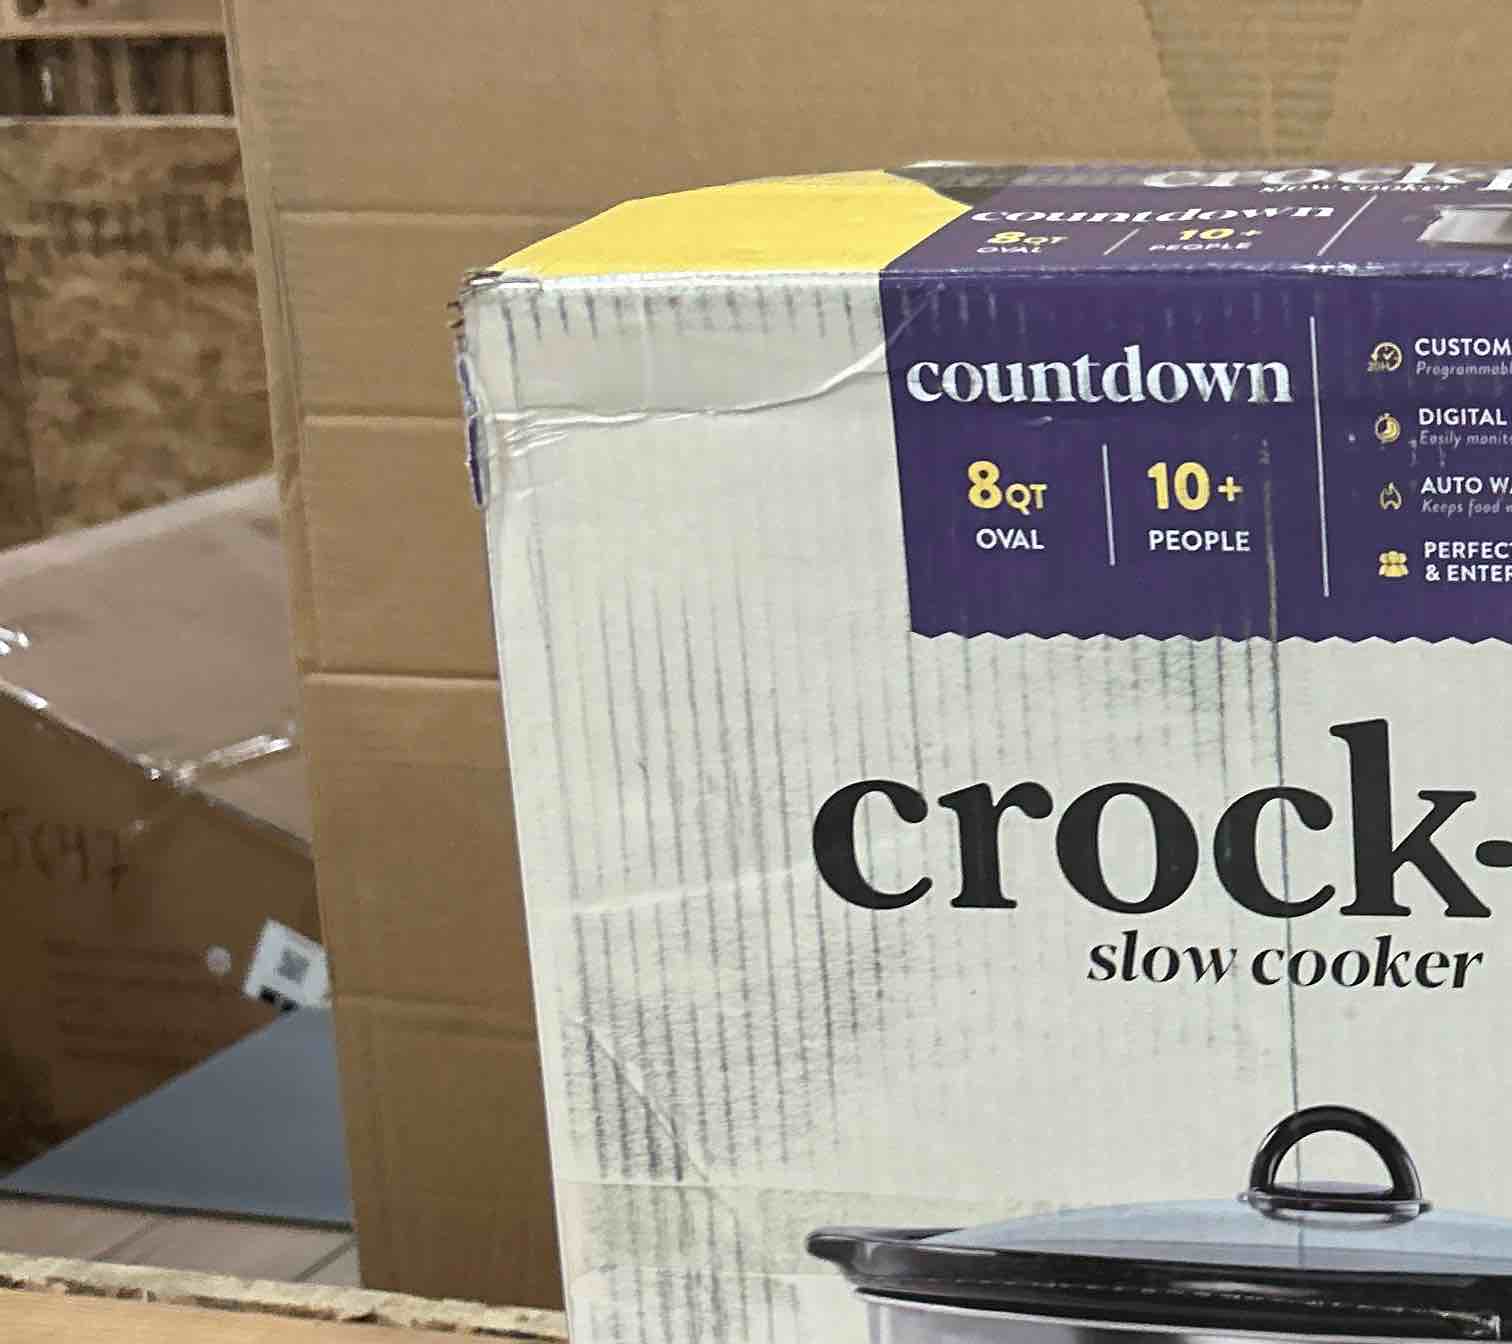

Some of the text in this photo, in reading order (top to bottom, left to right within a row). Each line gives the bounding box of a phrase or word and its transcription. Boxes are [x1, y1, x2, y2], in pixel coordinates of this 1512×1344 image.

[969, 206, 1335, 224] countdown
[1147, 241, 1253, 252] PEOPLE
[905, 344, 1295, 405] countdown
[1418, 407, 1508, 426] DIGITAL
[1418, 429, 1462, 449] Easily
[1146, 460, 1244, 512] 10+
[1420, 476, 1484, 495] AUTO
[1420, 497, 1464, 517] Keeps
[1467, 497, 1501, 517] food
[975, 527, 1046, 552] OVAL
[1148, 528, 1251, 553] PEOPLE
[1424, 564, 1441, 582] &
[1086, 929, 1484, 990] slow cooker
